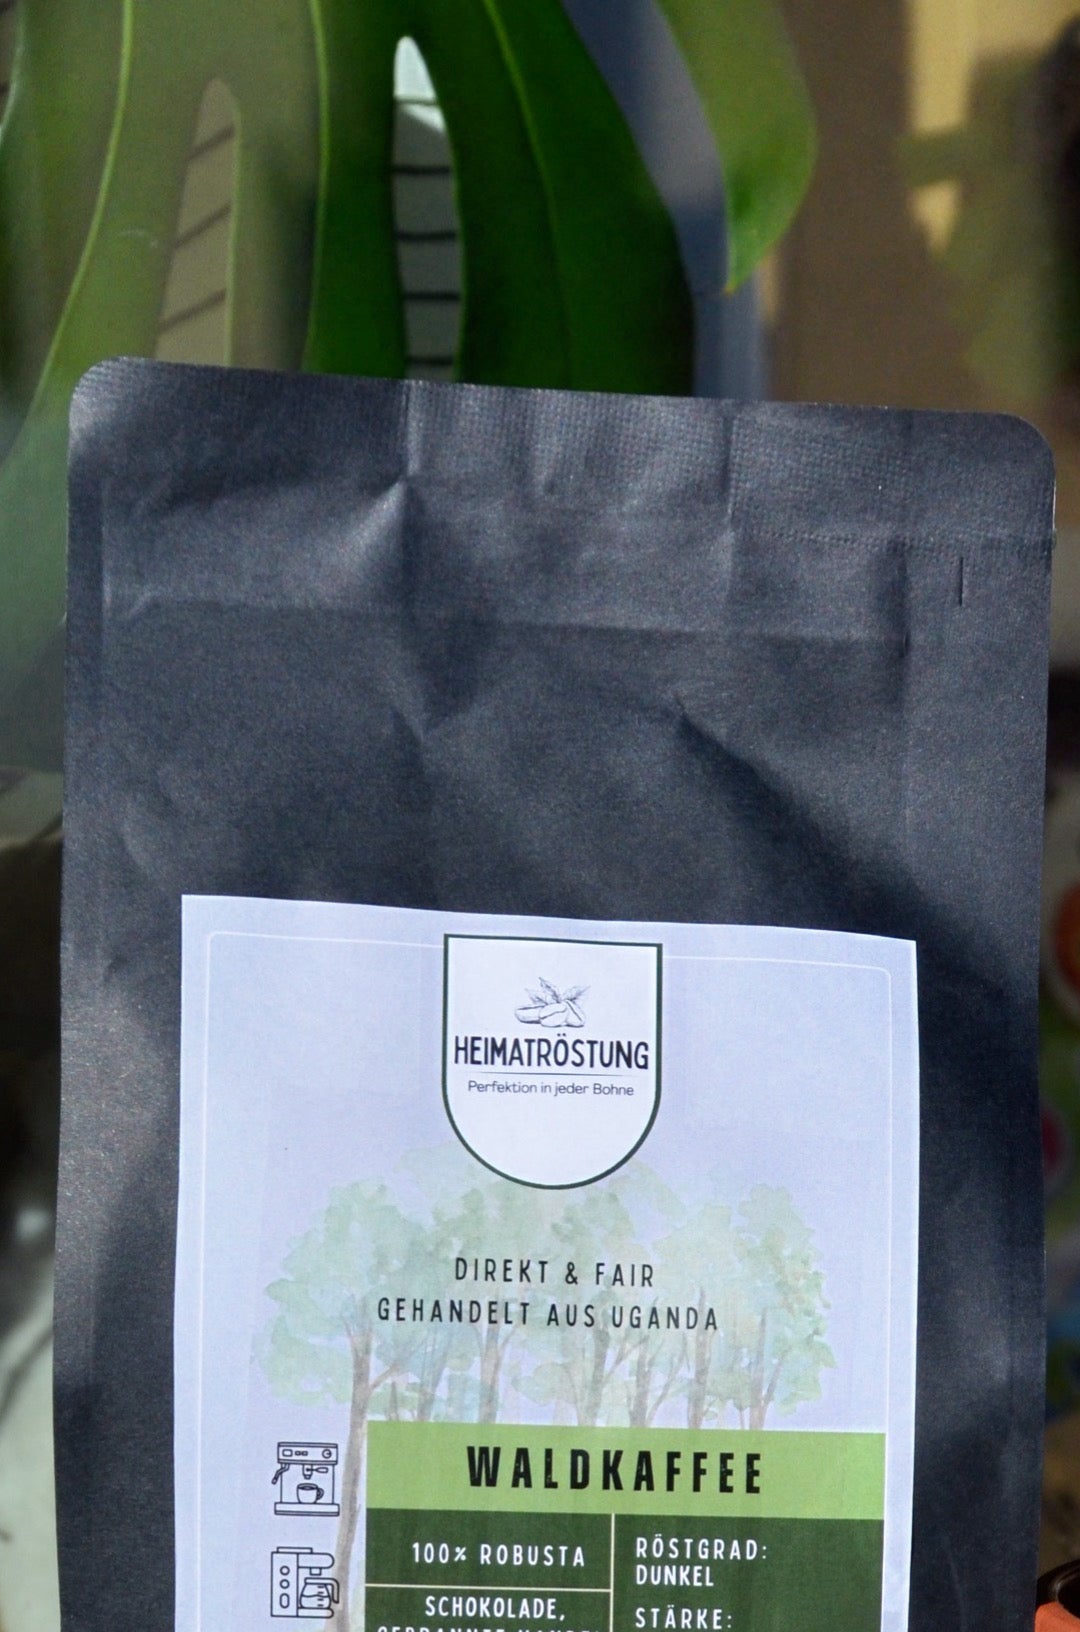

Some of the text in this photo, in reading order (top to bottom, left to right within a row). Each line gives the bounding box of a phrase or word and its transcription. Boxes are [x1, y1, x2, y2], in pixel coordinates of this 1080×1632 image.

[454, 1032, 649, 1070] HEIMATRÖSTUNG
[468, 1080, 634, 1097] Perfektion in jeder Bohne
[455, 1257, 654, 1288] DIREKT & FAIR
[378, 1297, 718, 1331] GEHANDELT AUS UGANDA
[466, 1445, 761, 1495] WALDKAFFEE
[412, 1542, 585, 1567] 100% ROBUSTA
[636, 1533, 767, 1560] RÖSTGRAD:
[636, 1564, 714, 1587] DUNKEL
[425, 1595, 566, 1621] SCHOKOLADE,
[635, 1604, 732, 1630] STÄRKE:
